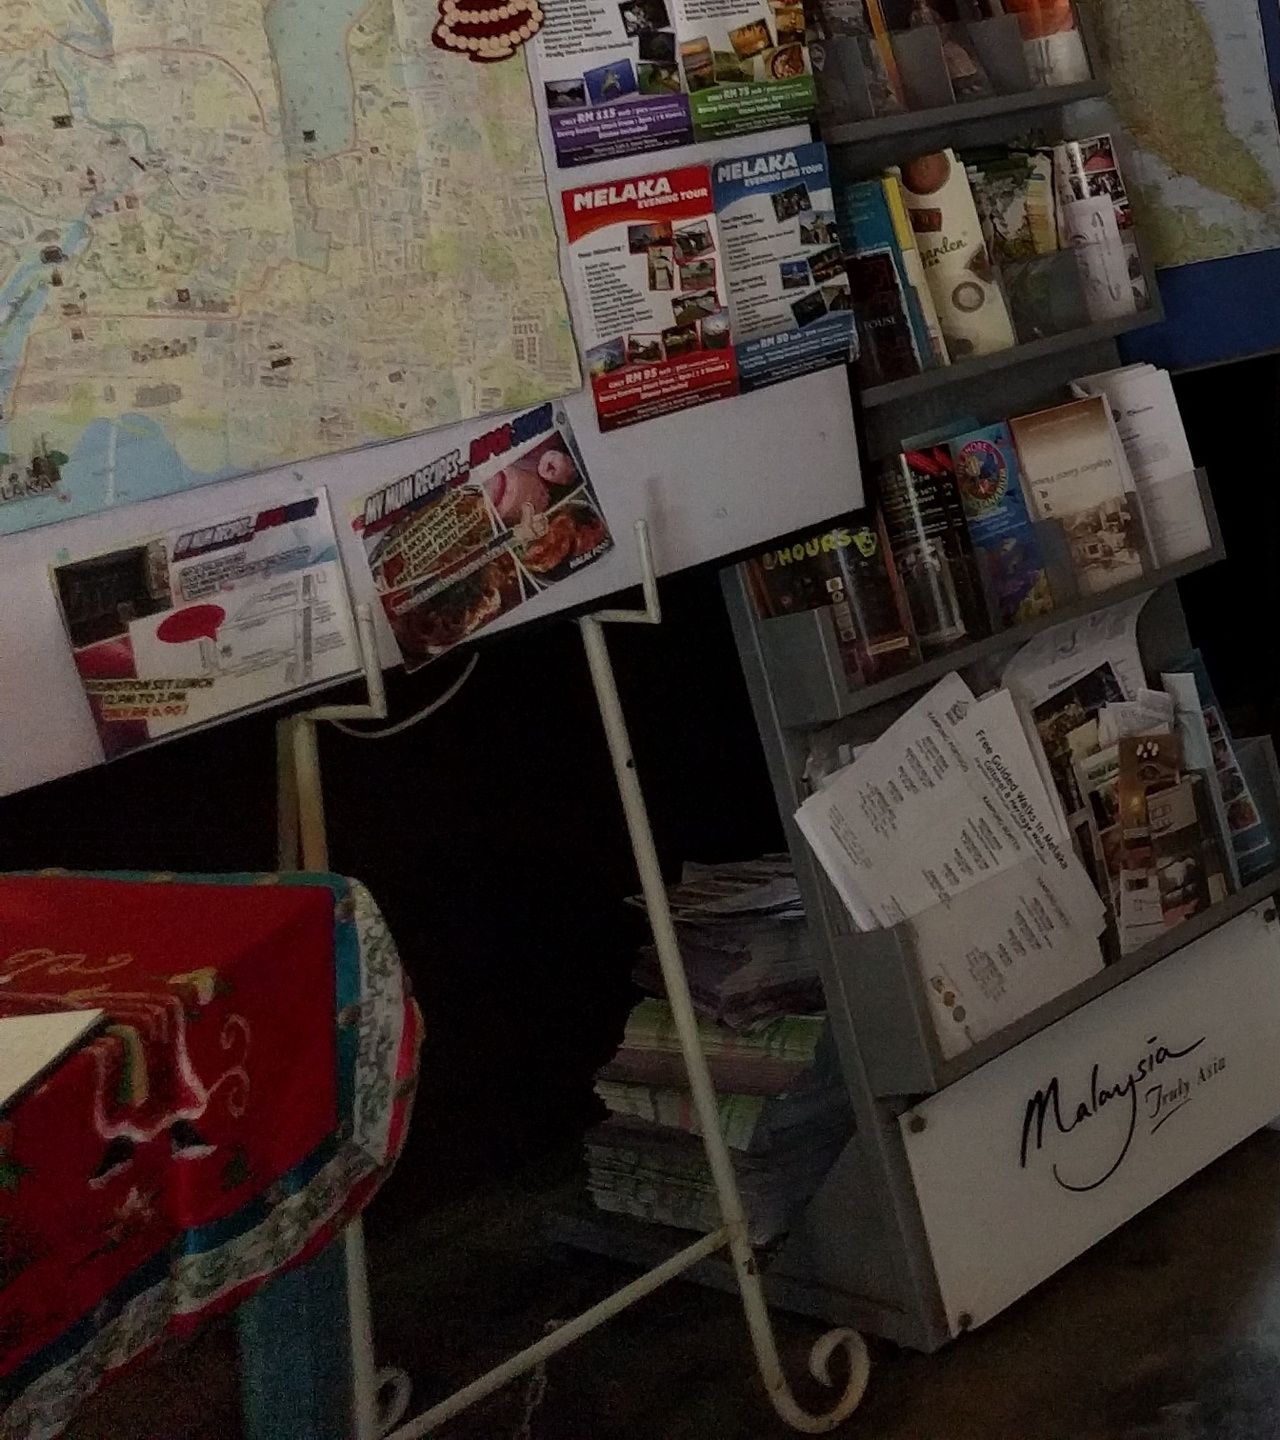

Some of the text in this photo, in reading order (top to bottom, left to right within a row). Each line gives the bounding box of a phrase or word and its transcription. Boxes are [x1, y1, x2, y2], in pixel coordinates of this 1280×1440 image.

[577, 112, 594, 123] RM
[718, 152, 797, 184] MELAKA
[573, 177, 672, 212] MELAKA
[679, 187, 709, 201] TOUR
[625, 371, 643, 385] RM
[974, 728, 996, 756] Free
[990, 753, 1019, 792] Guided
[1013, 791, 1038, 823] Walks
[1021, 1037, 1206, 1193] Malaysia
